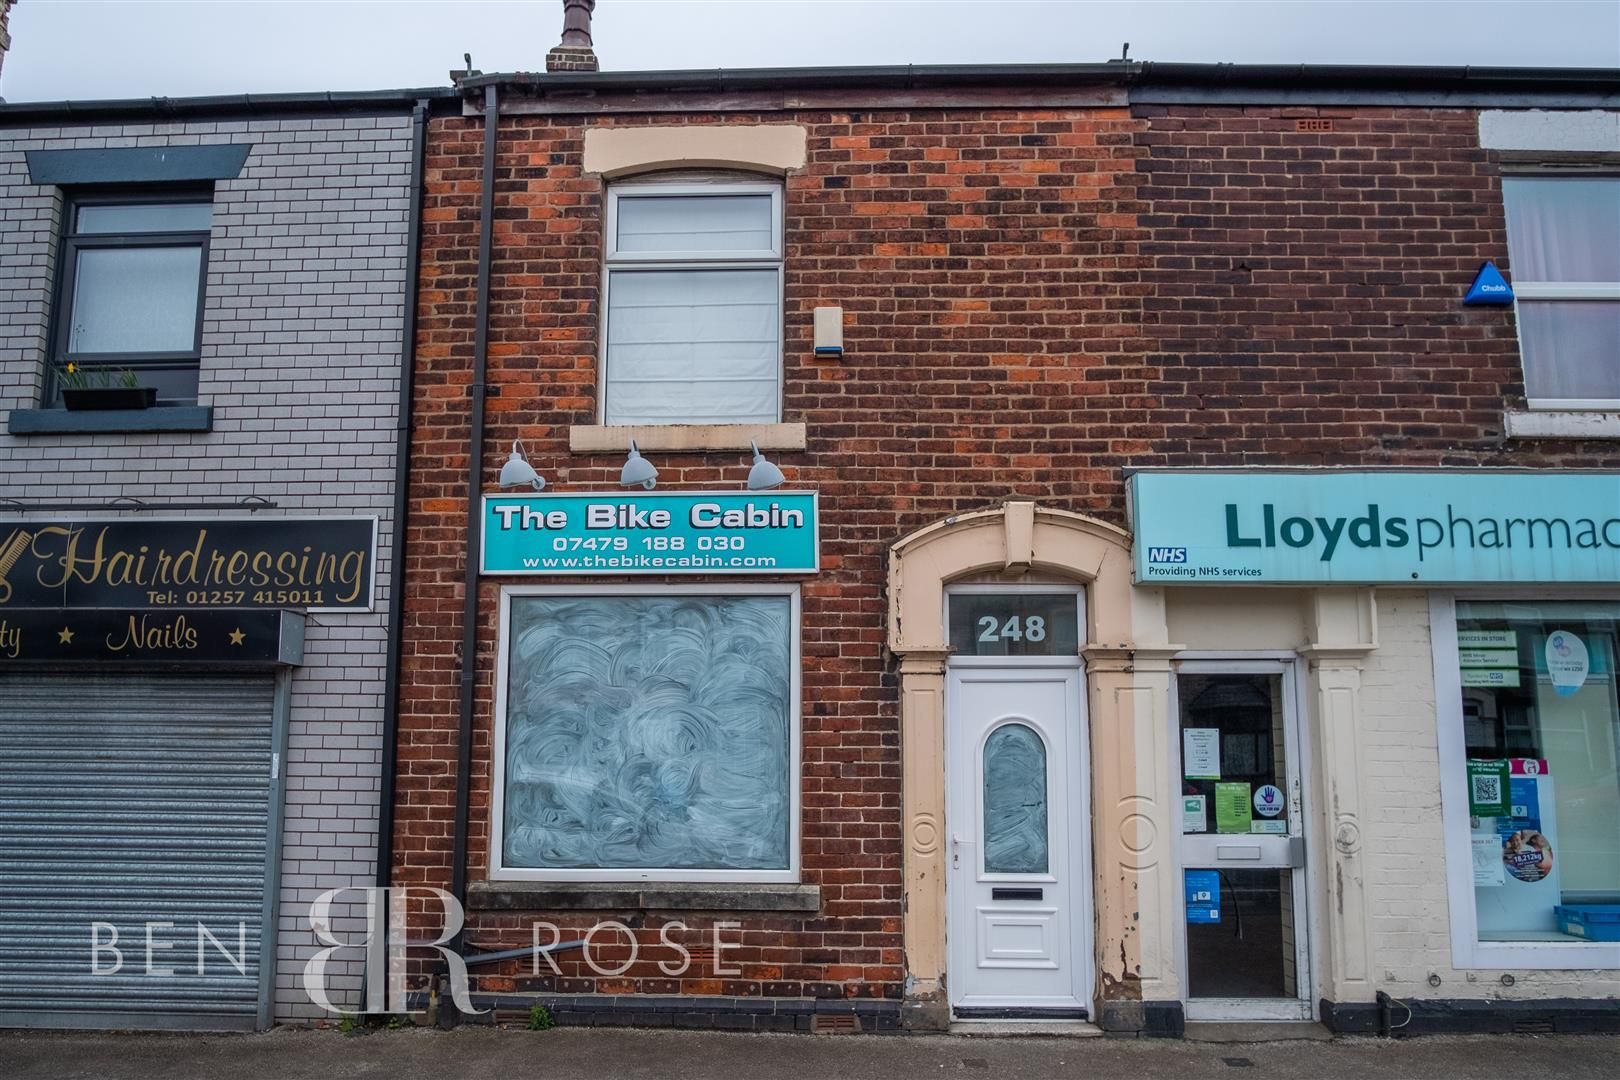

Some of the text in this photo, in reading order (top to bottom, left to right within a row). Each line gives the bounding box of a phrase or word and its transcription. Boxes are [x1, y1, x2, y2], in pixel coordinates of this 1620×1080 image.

[493, 503, 805, 530] The Bike Cabin
[553, 537, 745, 551] 07479 188 030
[523, 554, 776, 568] www.thebikecabin.com
[1149, 548, 1186, 562] NHS
[32, 526, 365, 603] Hairdressing
[1149, 567, 1262, 577] Providing NHS services
[147, 590, 324, 604] Tel: 01257 415011
[106, 614, 199, 651] Nails
[978, 615, 1046, 642] 248
